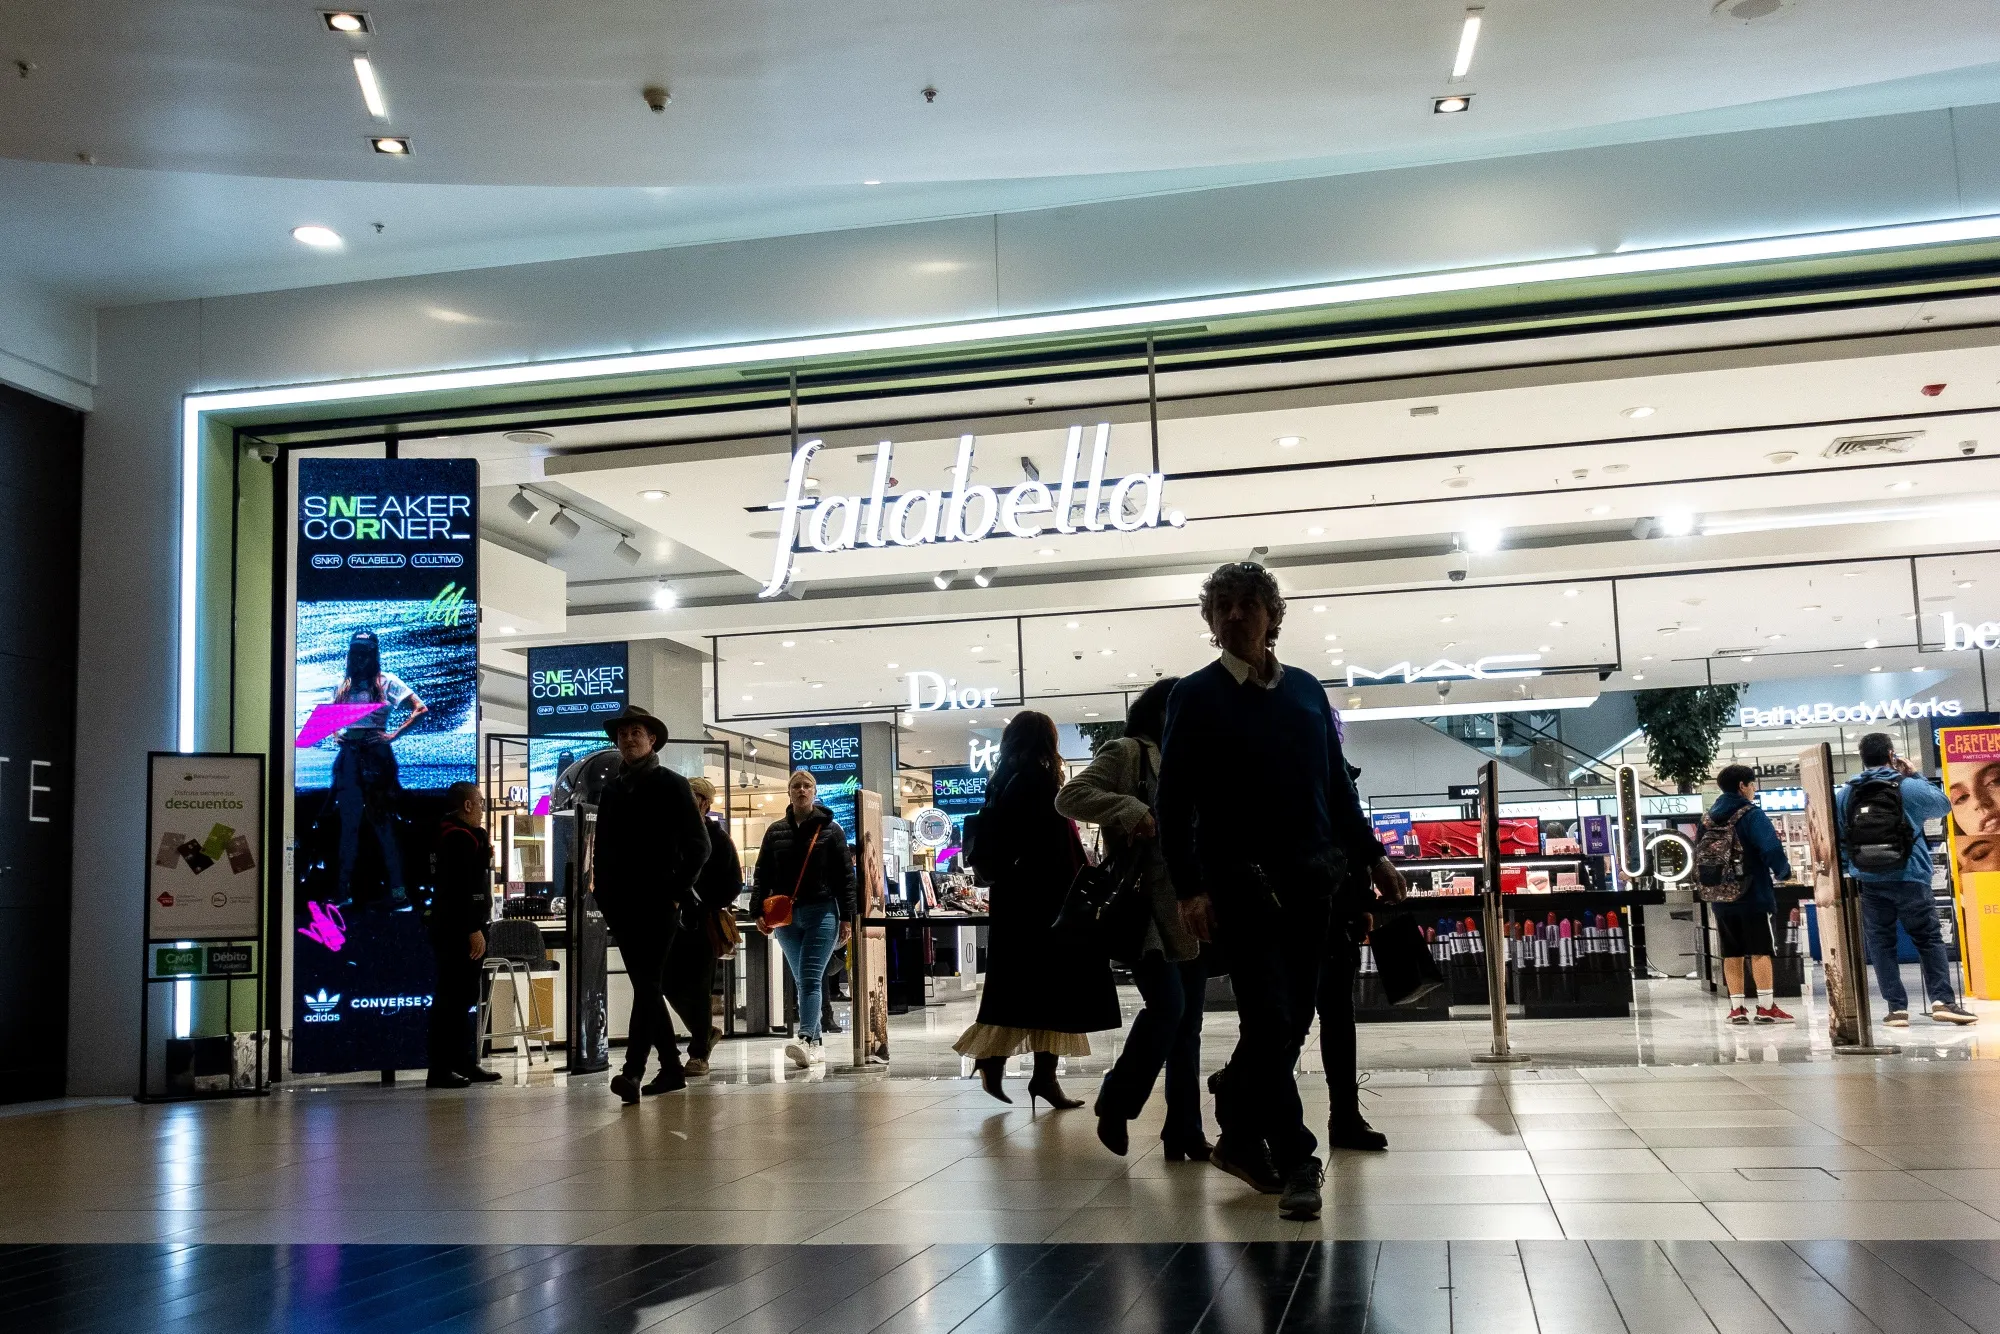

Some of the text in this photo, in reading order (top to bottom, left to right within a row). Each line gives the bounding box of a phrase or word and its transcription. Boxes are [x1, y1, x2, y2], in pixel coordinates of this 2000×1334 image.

[304, 495, 471, 517] SNEAKER
[314, 557, 340, 565] SNKR
[351, 556, 404, 565] FALABELLA
[1939, 611, 2000, 651] be
[532, 666, 624, 685] SNEAKER
[904, 671, 999, 713] Dior
[792, 737, 859, 751] SNEAKER
[934, 778, 987, 788] SNEAKER
[1461, 788, 1479, 796] LABIO
[165, 798, 243, 810] descuentos
[1649, 797, 1689, 814] NARS
[165, 953, 194, 964] CMR
[213, 952, 247, 962] Débito
[351, 997, 422, 1009] CONVERSE
[304, 1011, 341, 1022] adidas
